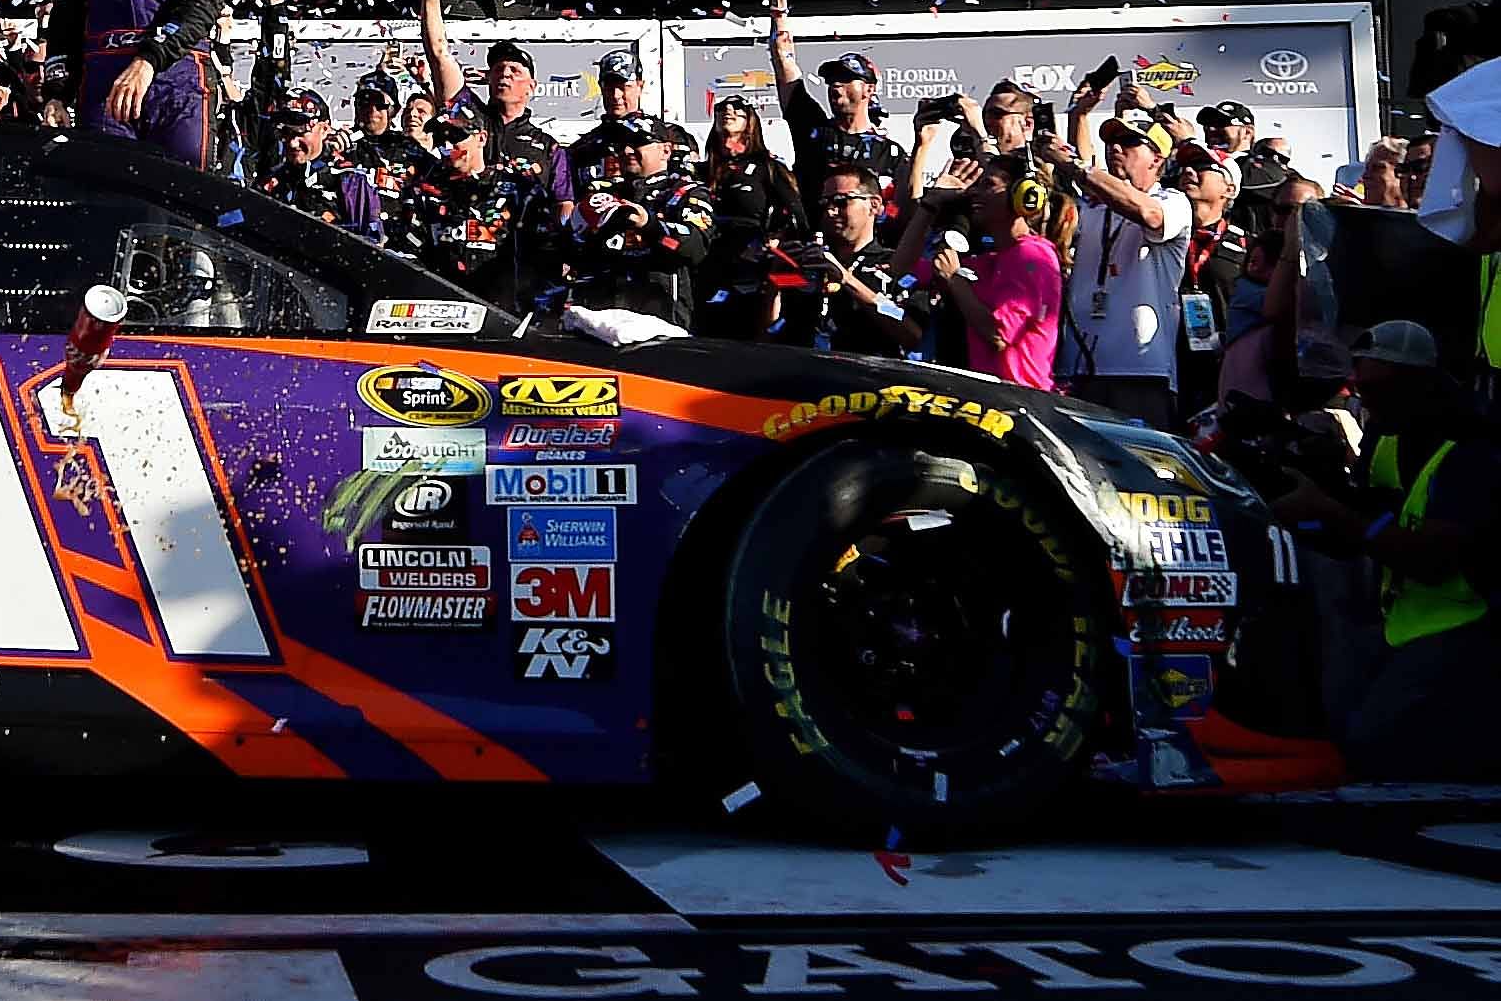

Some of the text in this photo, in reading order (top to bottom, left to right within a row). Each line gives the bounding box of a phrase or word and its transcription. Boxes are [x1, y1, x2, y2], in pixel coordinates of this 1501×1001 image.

[886, 68, 958, 83] FLORIDA
[1136, 69, 1195, 83] SUNOCO
[532, 79, 580, 98] print
[1254, 81, 1319, 95] TOYOTA
[412, 302, 469, 318] NASCAR
[375, 319, 470, 329] RACE CAR
[402, 390, 447, 407] Sprint
[502, 403, 618, 416] MECHANIX WEAR
[763, 385, 1016, 440] GOODYEAR
[509, 424, 615, 446] Duralast
[536, 450, 587, 461] BRAKES
[495, 467, 618, 495] Mobil 1
[545, 520, 607, 534] SHERWIN
[545, 533, 607, 548] WILLIAMS
[366, 549, 466, 567] LINCOLN
[389, 572, 477, 587] WELDERS
[515, 566, 612, 618] 3M
[362, 596, 486, 627] FLOWMASTER
[518, 628, 610, 654] K&
[524, 654, 591, 680] N
